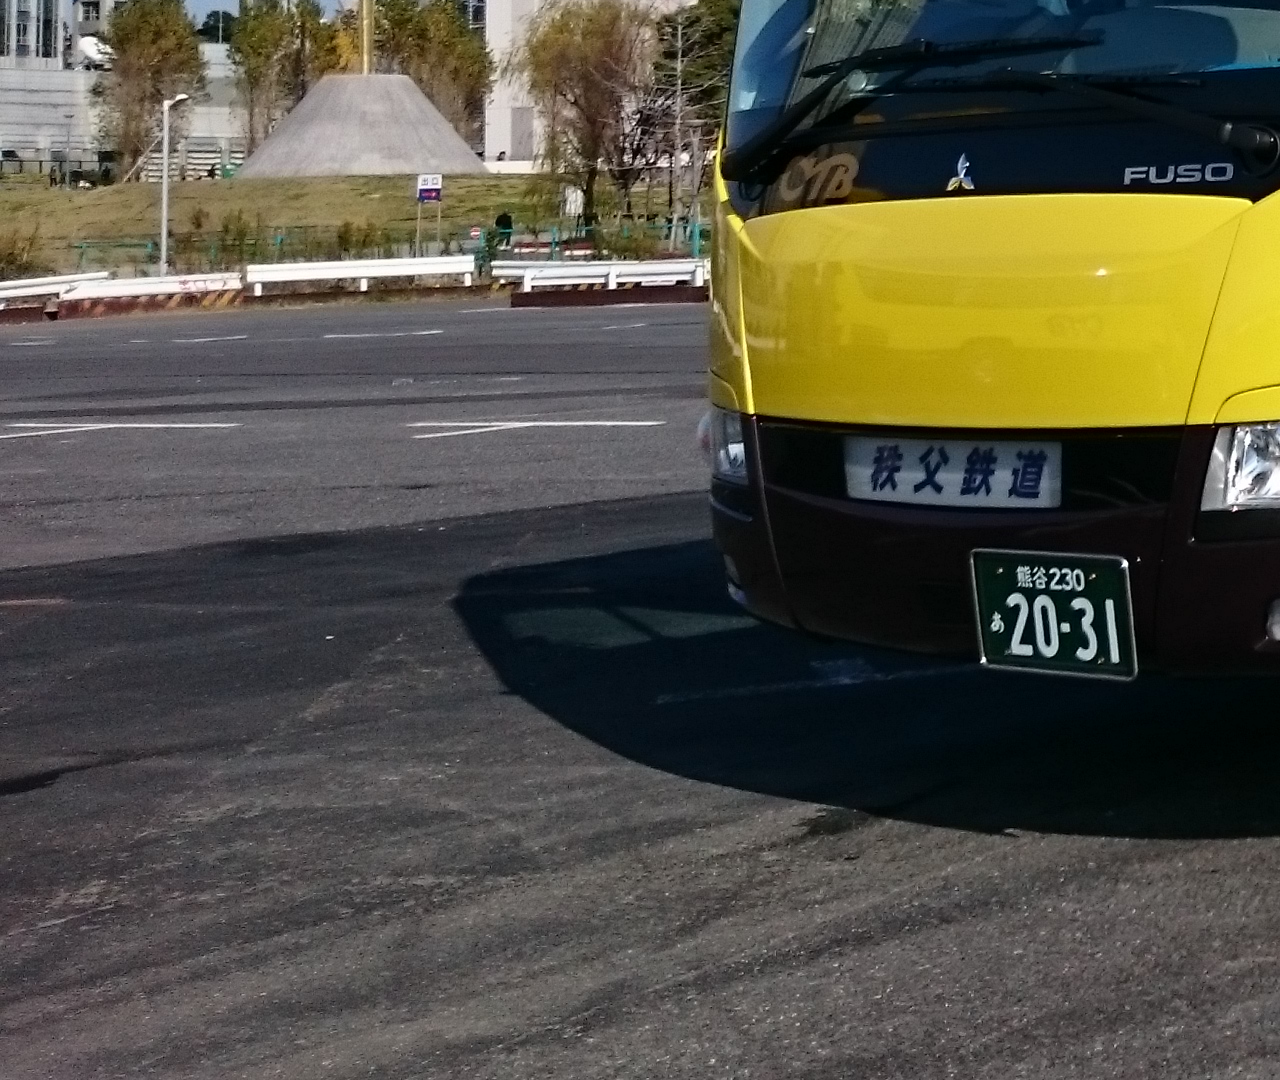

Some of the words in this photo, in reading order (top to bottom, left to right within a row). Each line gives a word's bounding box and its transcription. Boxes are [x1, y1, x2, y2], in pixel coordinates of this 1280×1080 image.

[1123, 162, 1234, 185] FUSO
[871, 444, 1048, 499] 秩父鉄道
[990, 611, 1005, 634] あ
[1005, 592, 1121, 664] 20-31
